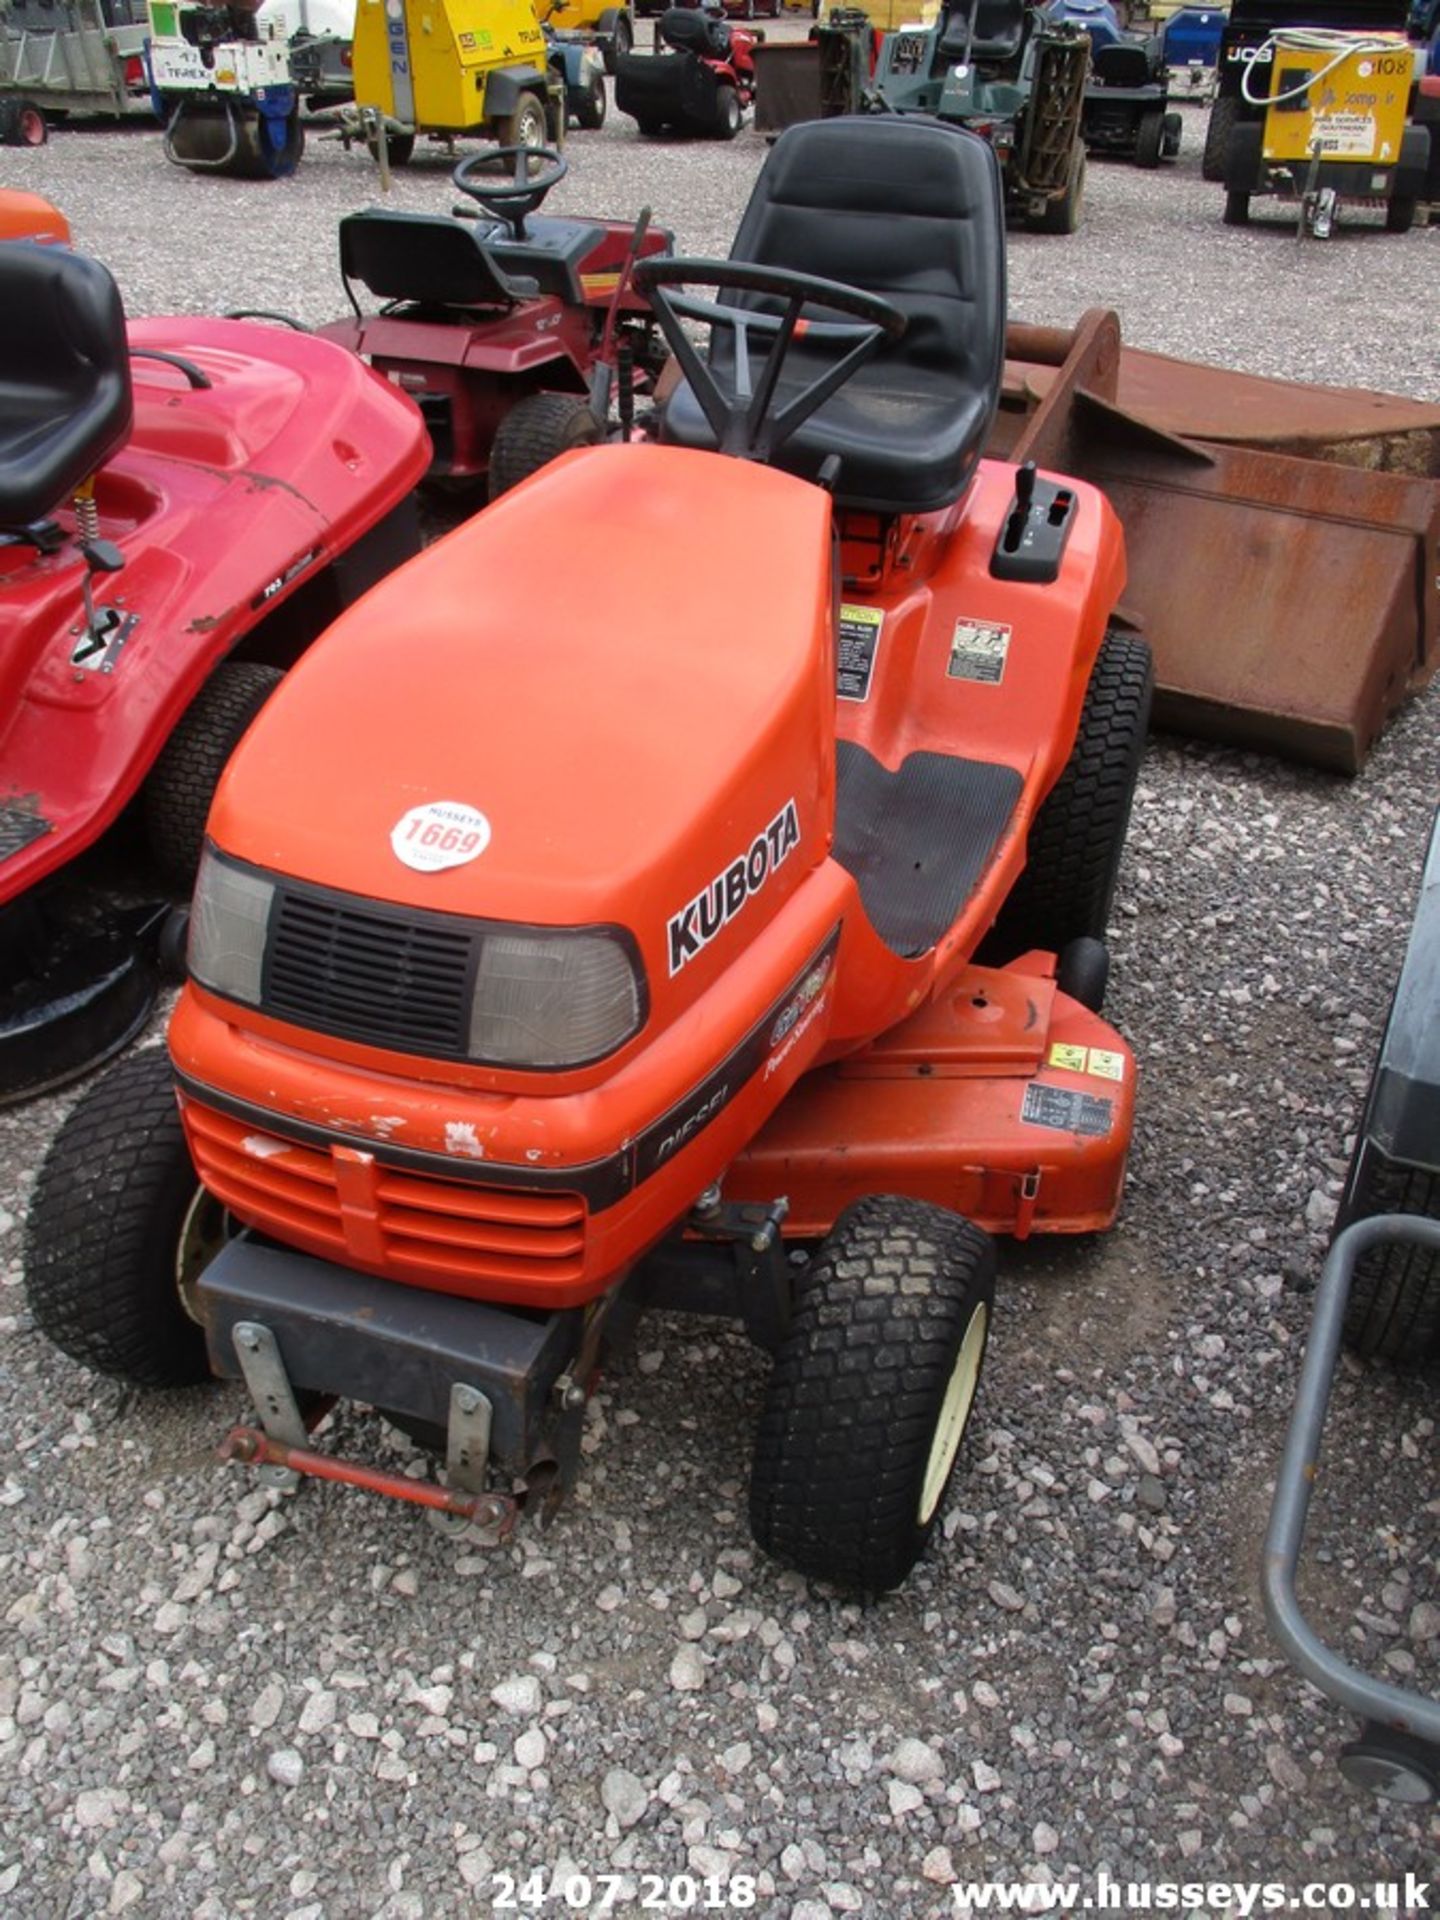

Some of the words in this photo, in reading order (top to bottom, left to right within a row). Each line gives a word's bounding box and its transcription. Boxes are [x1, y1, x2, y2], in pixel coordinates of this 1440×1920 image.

[1228, 47, 1273, 62] JCB
[429, 807, 482, 827] HUSSEYS
[405, 818, 481, 854] 1669
[668, 799, 800, 977] KUBOTA
